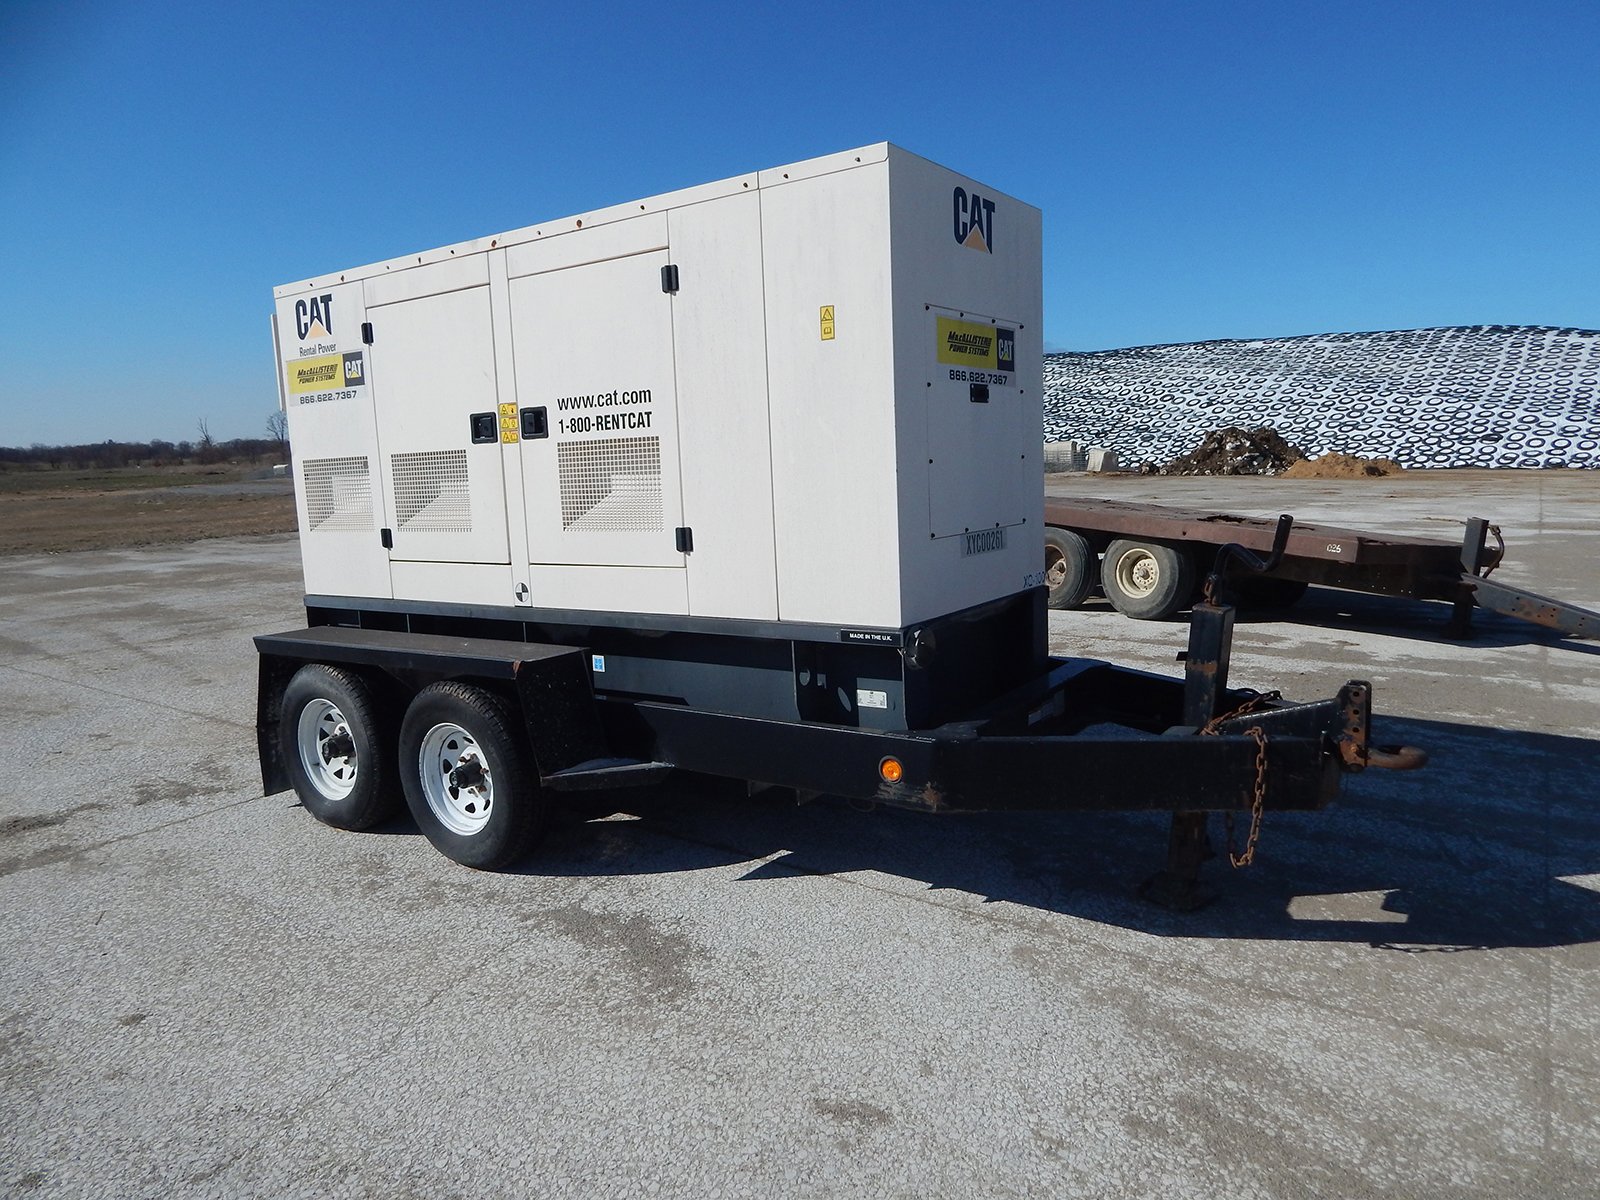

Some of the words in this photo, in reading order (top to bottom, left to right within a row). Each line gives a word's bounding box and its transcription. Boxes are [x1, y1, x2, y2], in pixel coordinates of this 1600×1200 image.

[953, 186, 995, 254] CAT
[295, 293, 332, 340] CAT
[299, 344, 317, 357] Rental
[318, 343, 337, 354] Power
[998, 338, 1013, 361] CAT
[344, 359, 362, 379] CAT
[949, 369, 1008, 385] 866.622.7367
[300, 390, 357, 404] 866.622.7367
[557, 389, 652, 411] www.cat.com
[558, 411, 652, 434] 1-800-RENTCAT
[1326, 543, 1342, 554] 026
